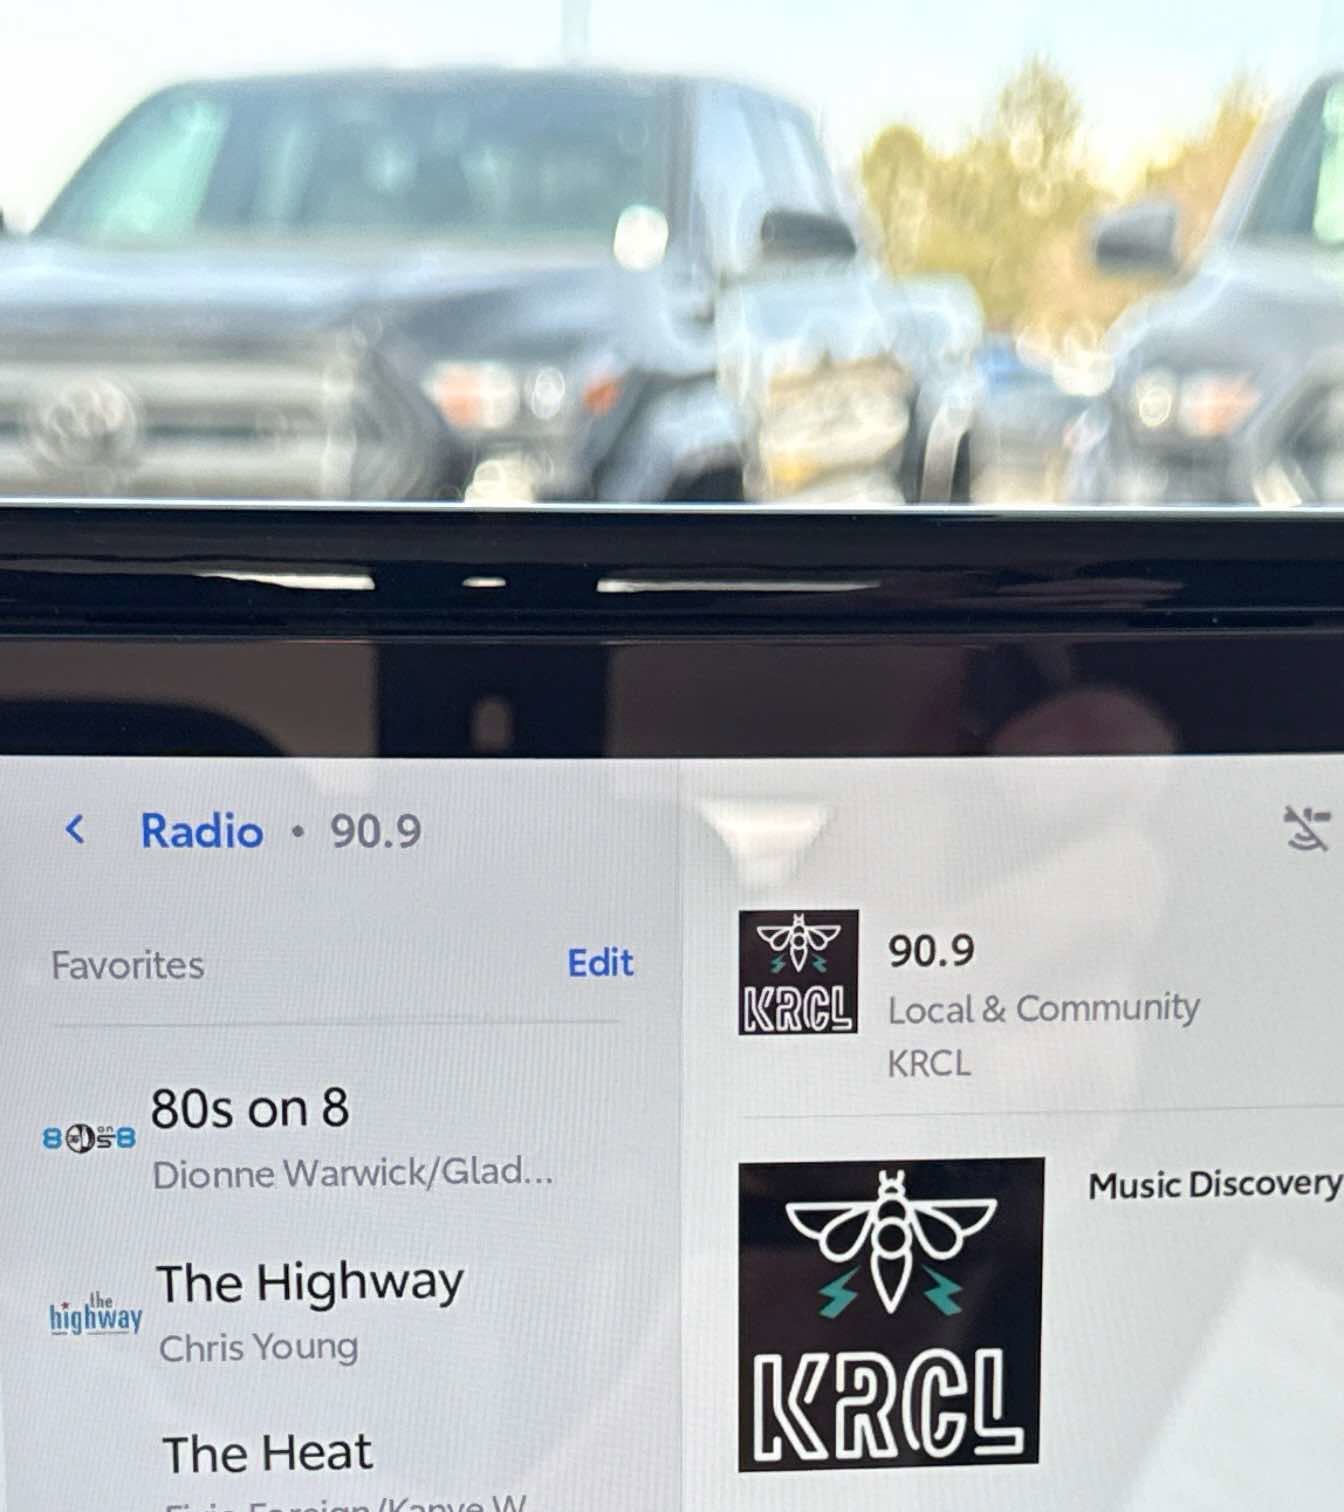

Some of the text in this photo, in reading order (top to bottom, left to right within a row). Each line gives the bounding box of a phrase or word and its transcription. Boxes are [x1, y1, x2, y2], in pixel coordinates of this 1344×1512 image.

[142, 812, 422, 850] Radio 90.9
[52, 947, 634, 980] Favorites Edit
[888, 934, 974, 968] 90.9
[744, 985, 852, 1032] KRCL
[889, 992, 1200, 1027] Local & Community
[889, 1049, 972, 1077] KRCL
[151, 1086, 349, 1129] 80s on 8
[154, 1161, 275, 1190] Dionne
[1090, 1170, 1181, 1200] Music
[1190, 1169, 1344, 1202] Discovery
[90, 1291, 113, 1308] the
[157, 1260, 464, 1311] The Highway
[49, 1302, 143, 1335] highway
[159, 1333, 358, 1365] Chris Young
[752, 1348, 1025, 1462] KRCL
[162, 1433, 374, 1474] The Heat
